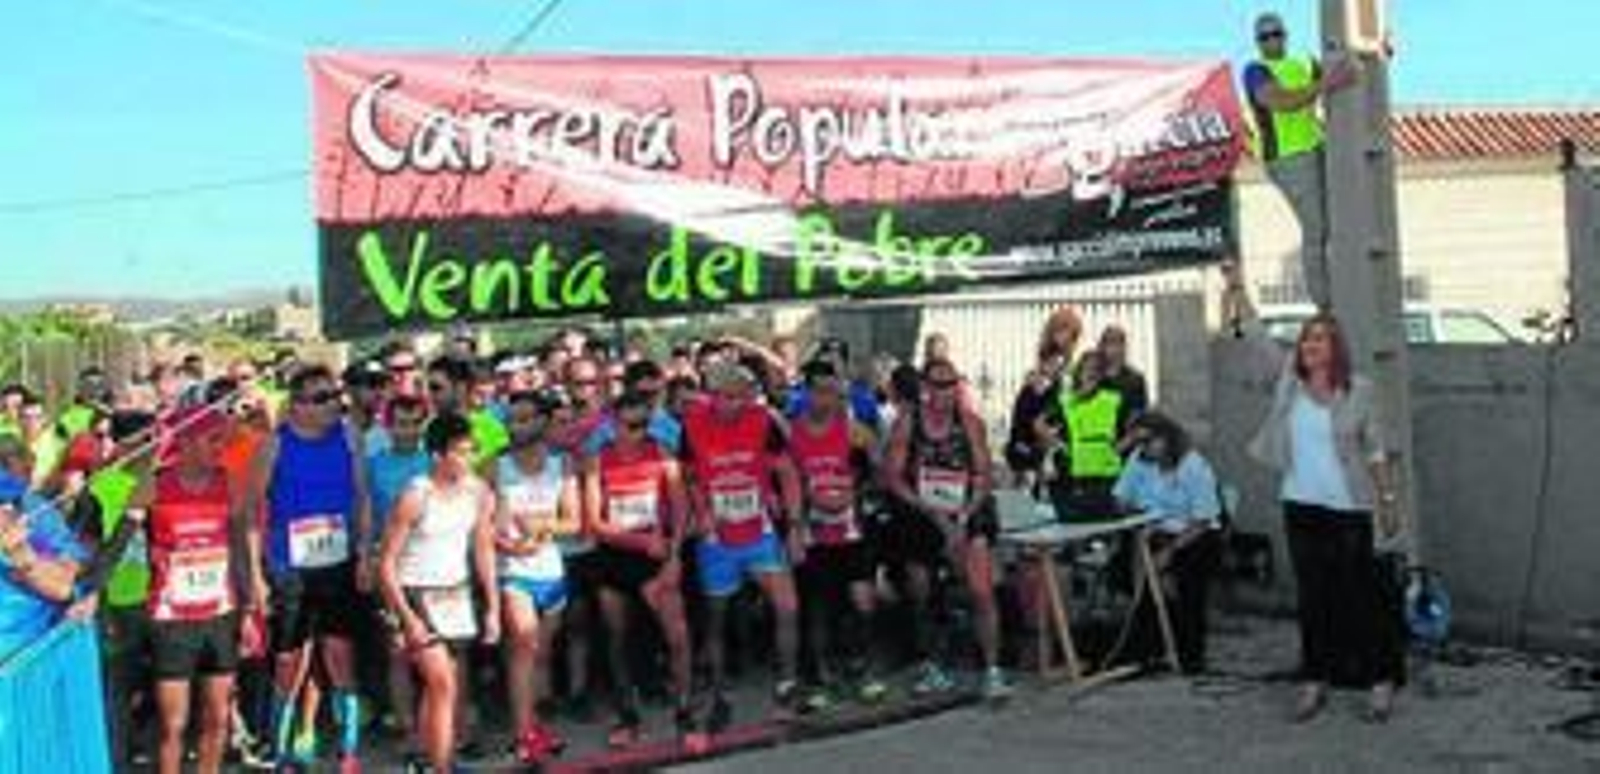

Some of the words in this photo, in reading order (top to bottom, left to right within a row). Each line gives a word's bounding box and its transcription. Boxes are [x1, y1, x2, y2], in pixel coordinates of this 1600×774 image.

[348, 72, 677, 174] Carrera
[710, 72, 962, 194] Popula
[357, 229, 610, 319] Venta
[646, 219, 760, 302] del
[795, 210, 985, 291] Pobre
